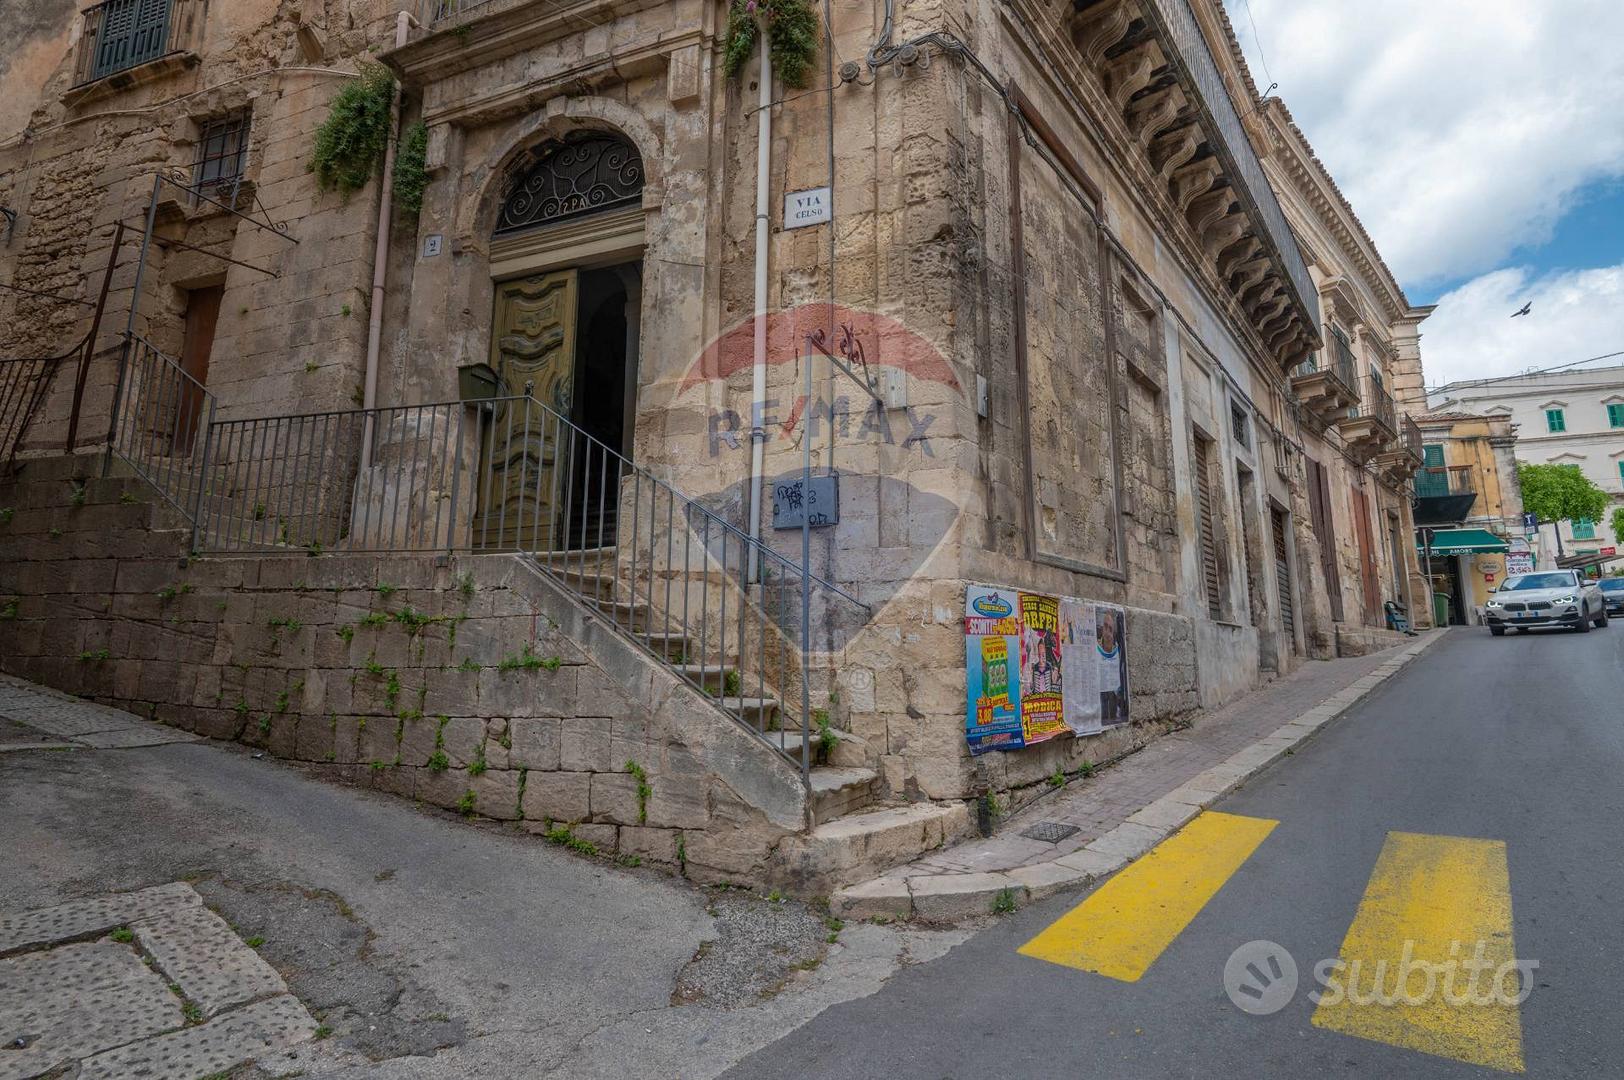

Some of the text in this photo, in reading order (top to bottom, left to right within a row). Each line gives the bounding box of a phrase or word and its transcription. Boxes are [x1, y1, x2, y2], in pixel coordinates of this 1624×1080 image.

[797, 196, 820, 208] VIA
[796, 208, 823, 219] CELSO
[1023, 610, 1057, 634] ORFEI
[1023, 700, 1062, 714] MODICA
